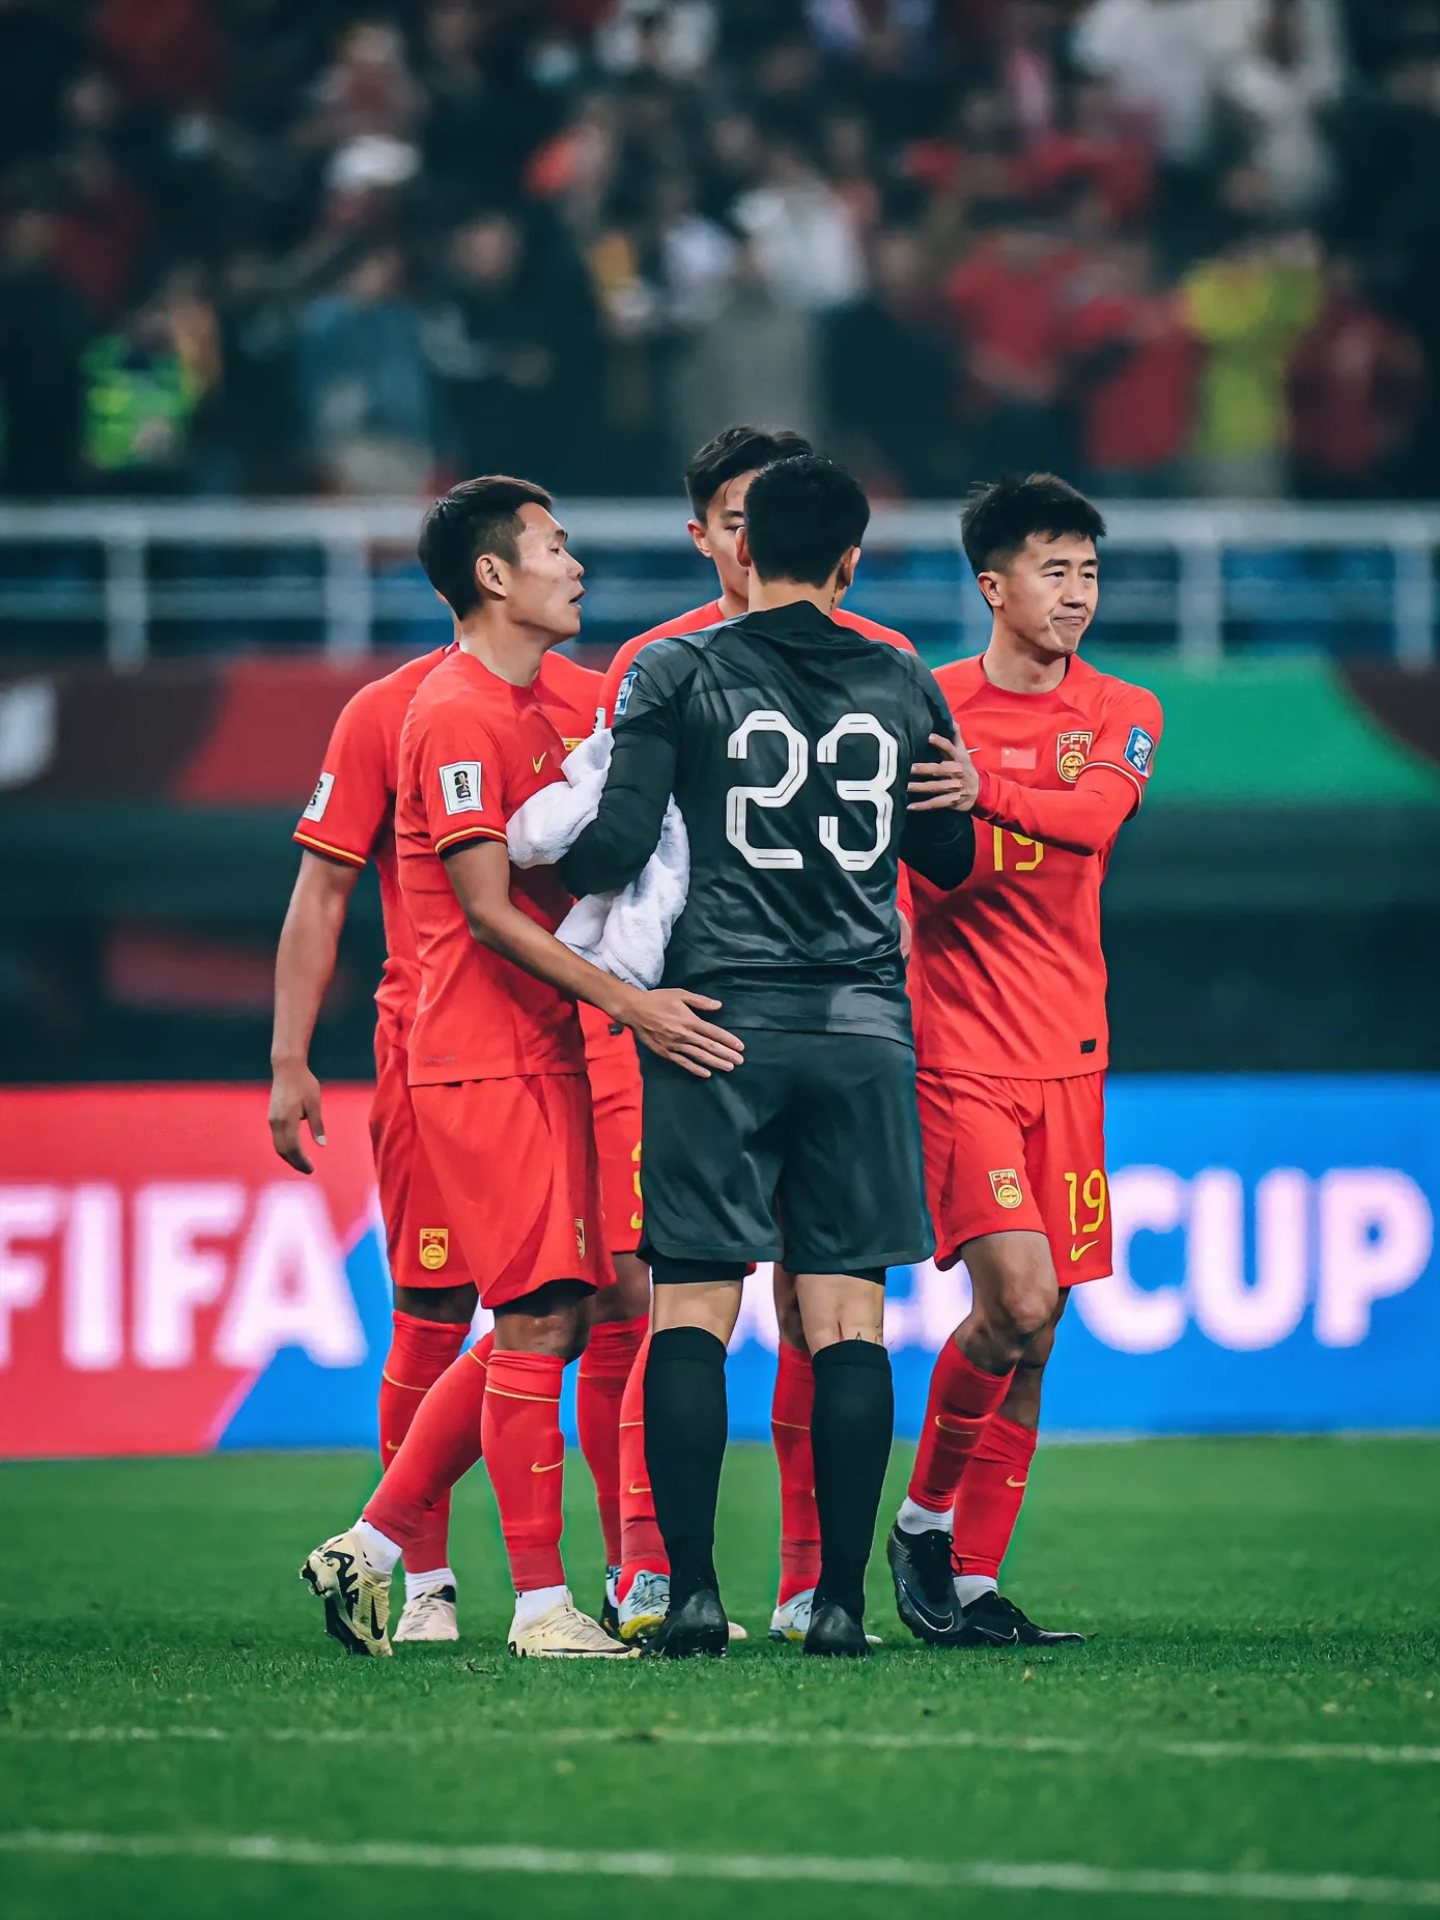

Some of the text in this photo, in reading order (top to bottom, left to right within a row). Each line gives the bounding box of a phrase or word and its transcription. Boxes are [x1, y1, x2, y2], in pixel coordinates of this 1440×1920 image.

[725, 709, 899, 872] 23
[1060, 734, 1089, 745] CFA
[1063, 1168, 1106, 1236] 19
[1071, 1165, 1433, 1353] CUP
